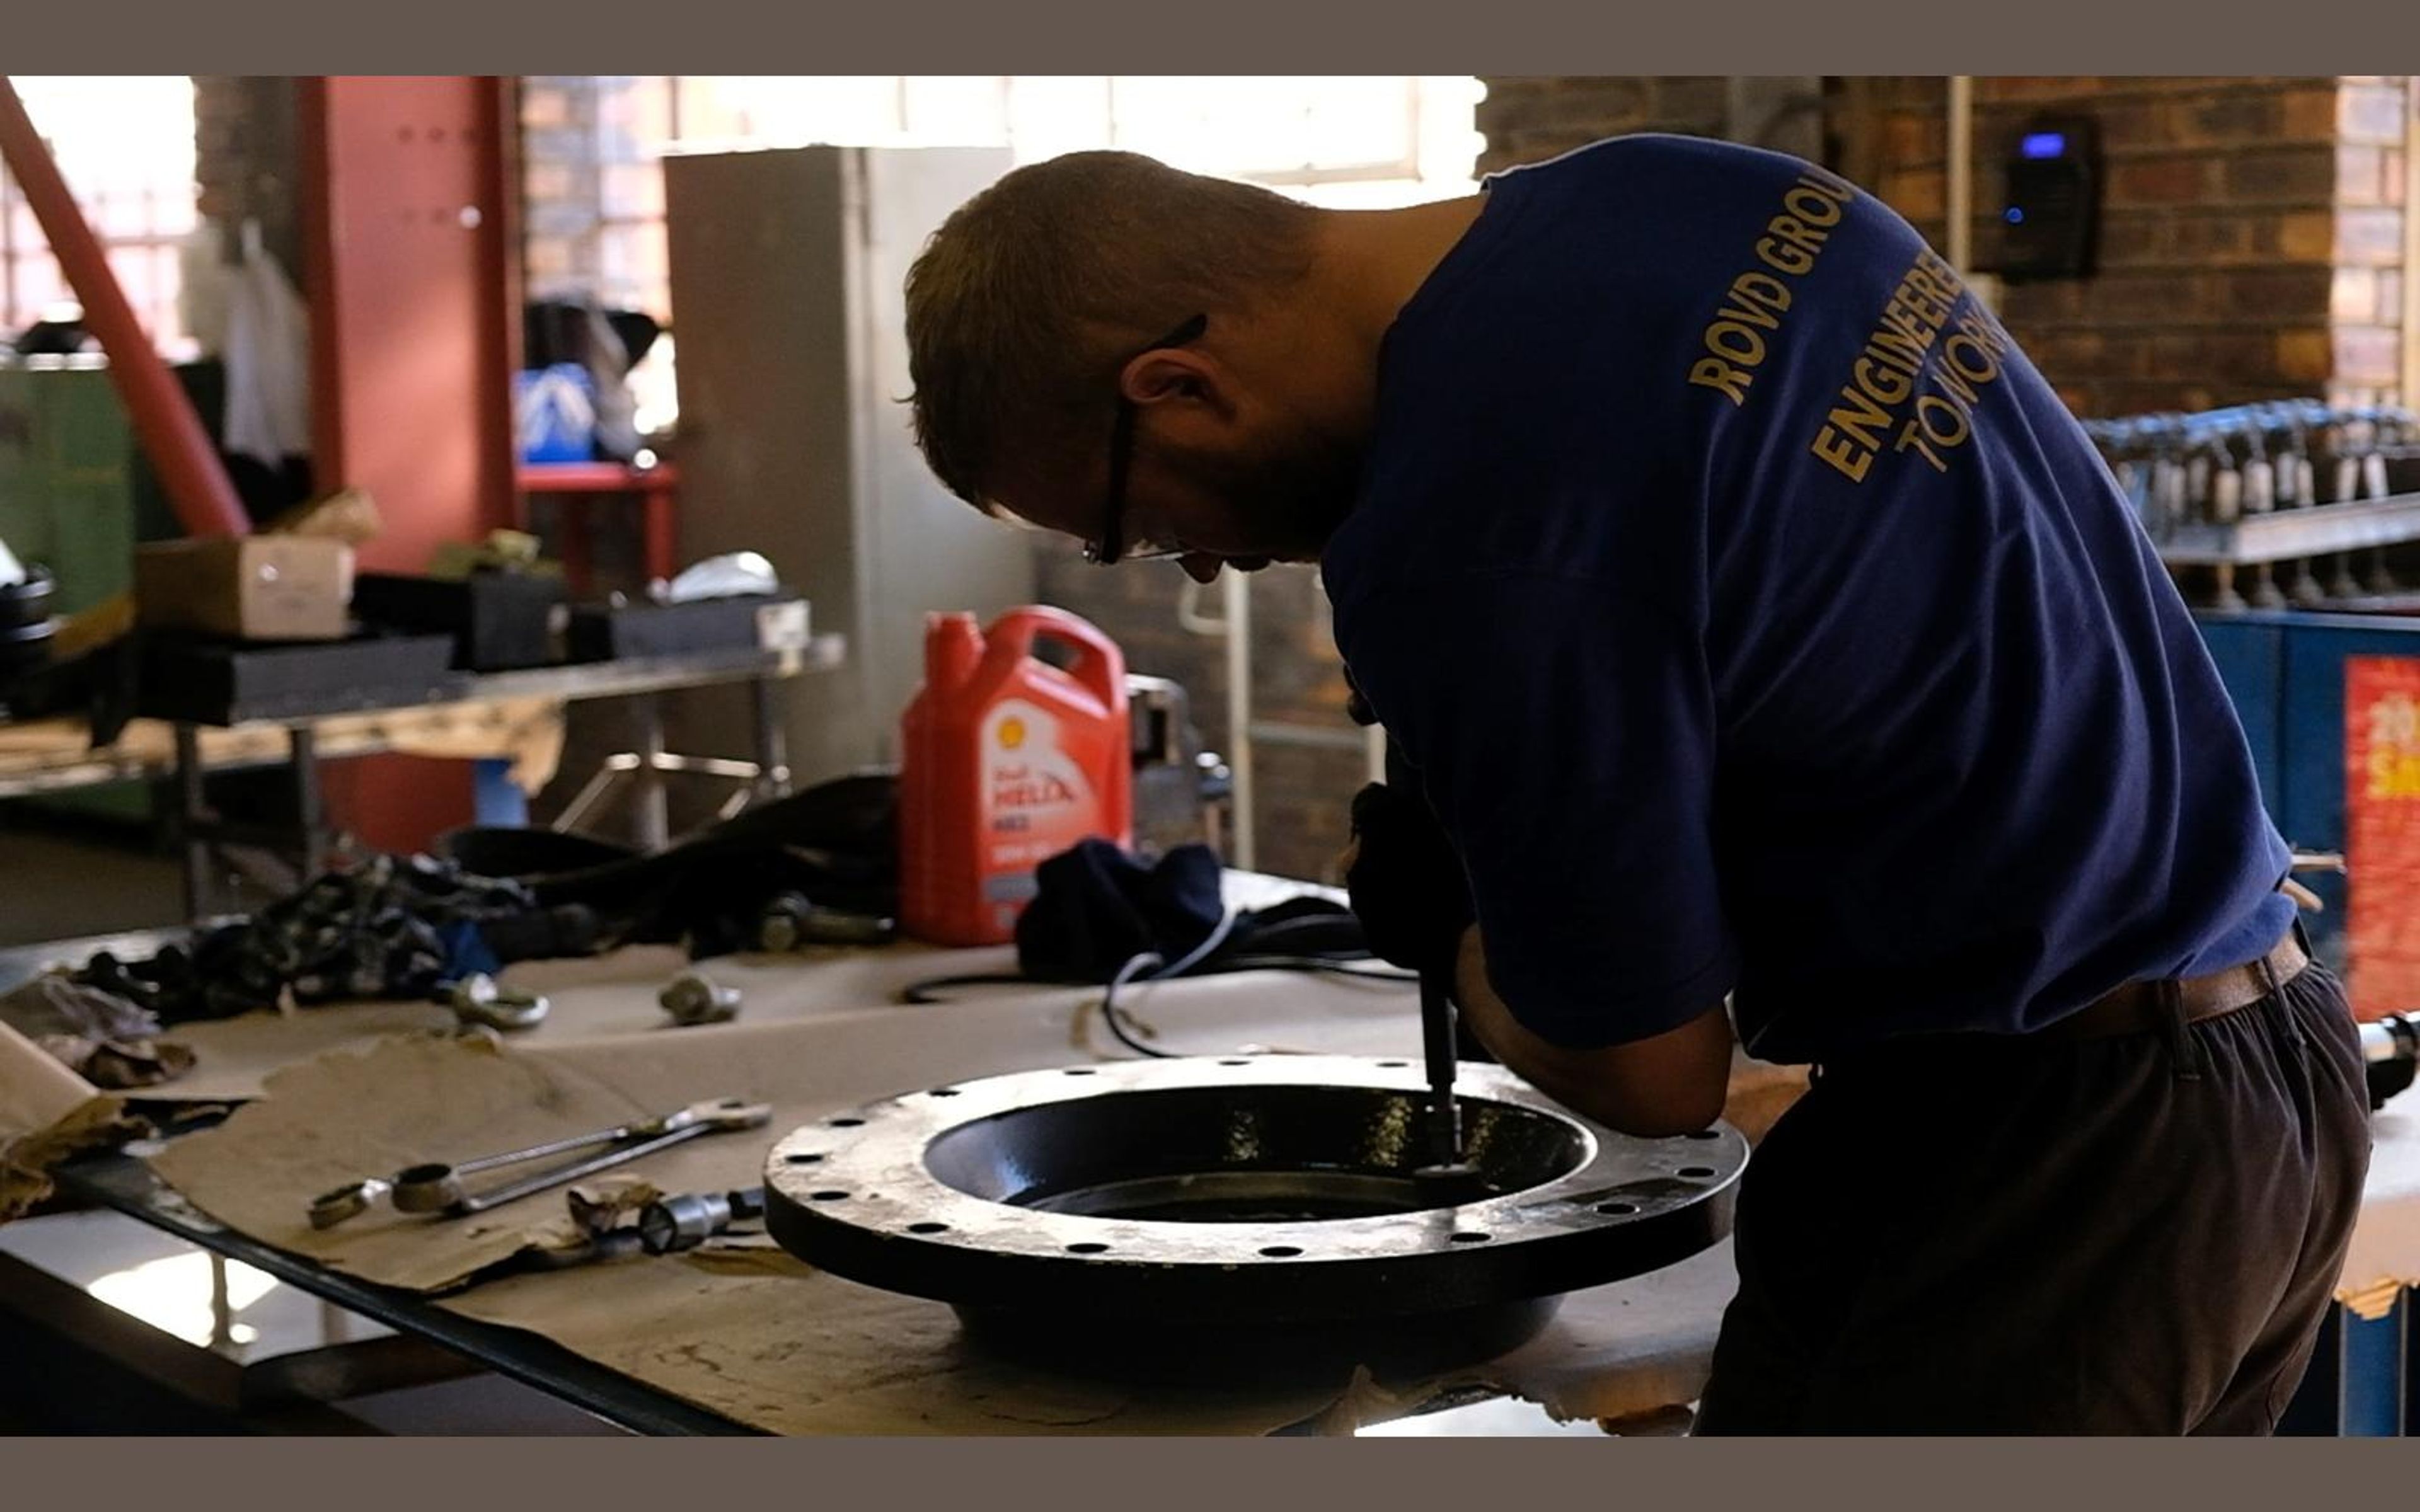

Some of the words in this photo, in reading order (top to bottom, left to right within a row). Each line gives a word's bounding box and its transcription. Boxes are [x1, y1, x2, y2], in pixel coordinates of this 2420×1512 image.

[1688, 271, 1792, 406] ROVD
[1755, 176, 1853, 275] GROU
[1811, 251, 1962, 483] ENGINEERE
[1893, 394, 1969, 474] TO
